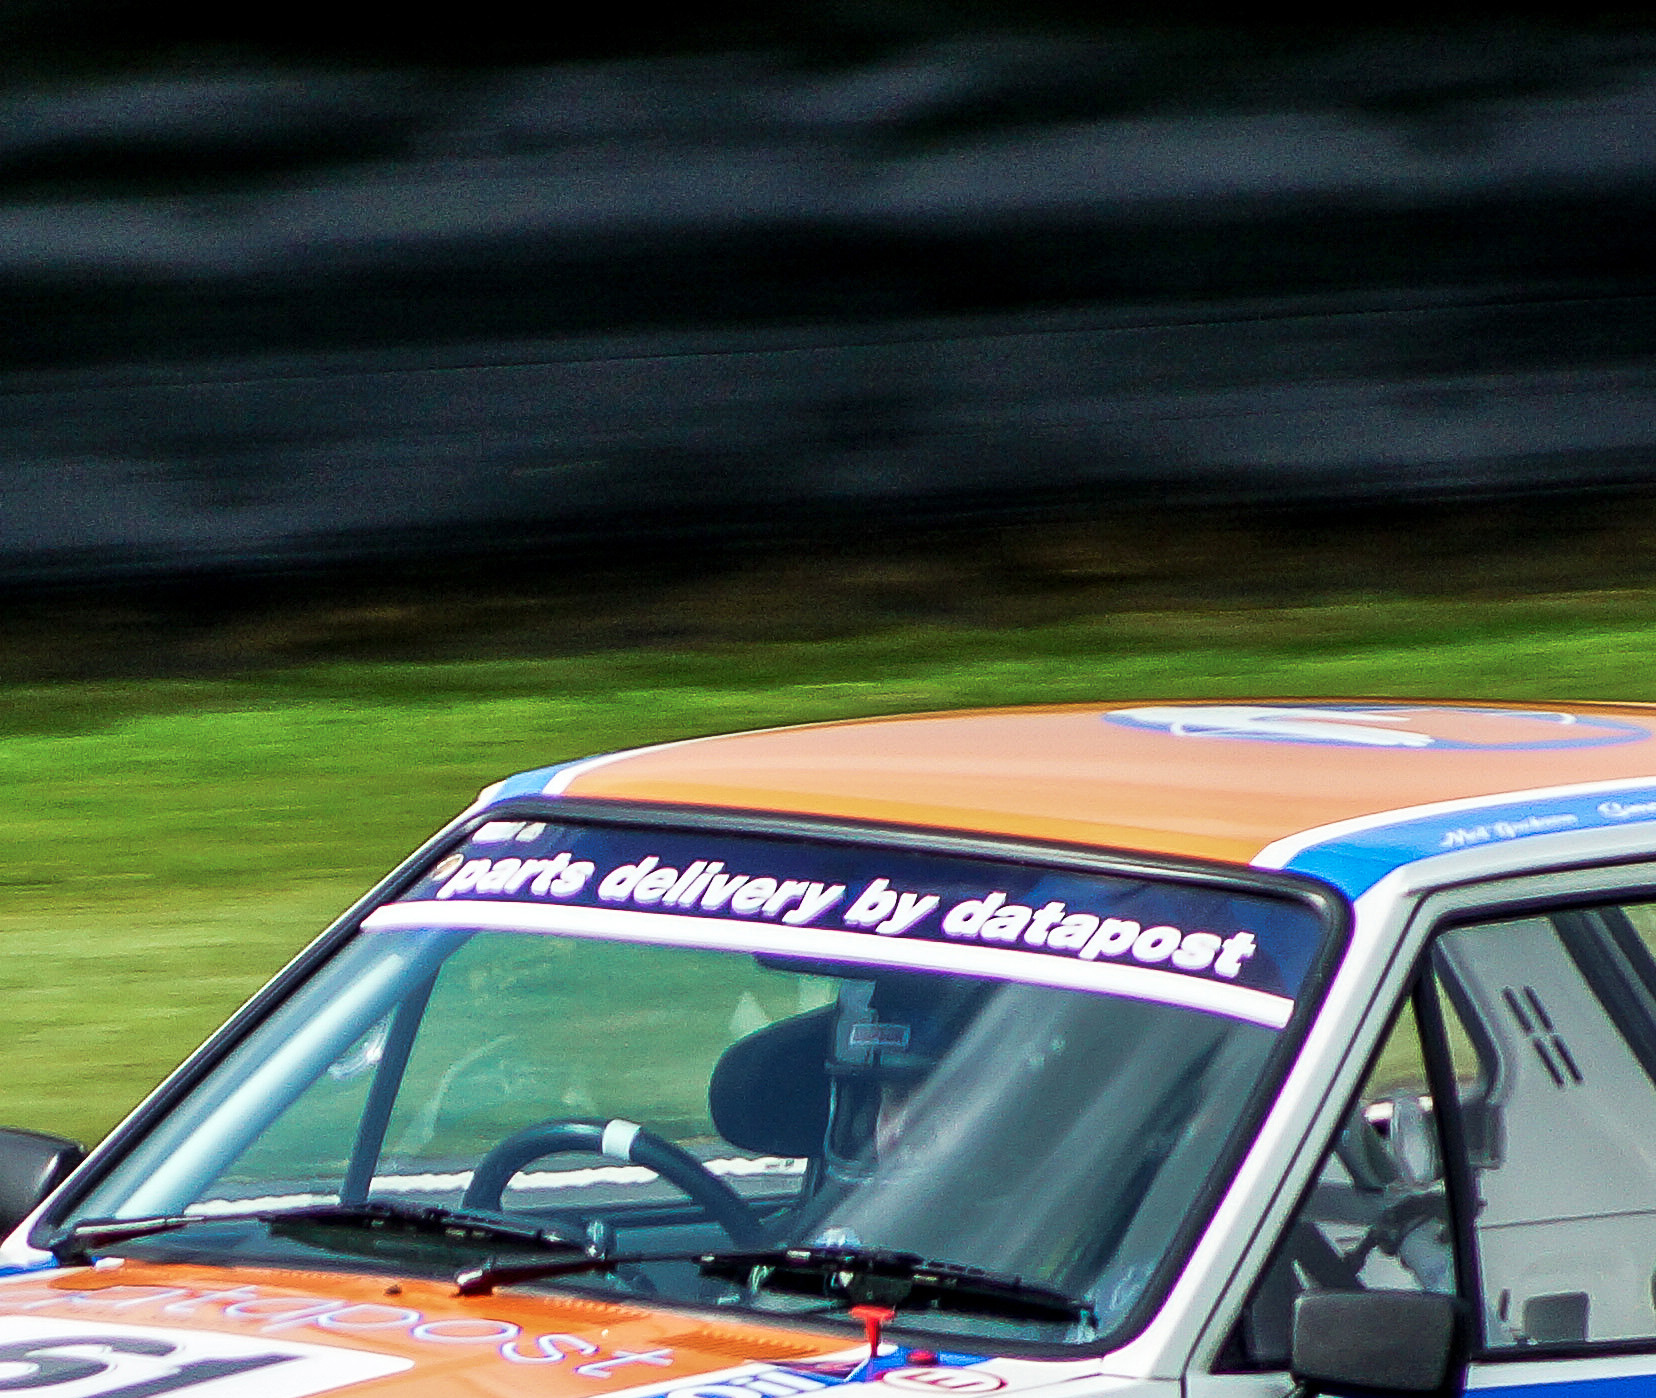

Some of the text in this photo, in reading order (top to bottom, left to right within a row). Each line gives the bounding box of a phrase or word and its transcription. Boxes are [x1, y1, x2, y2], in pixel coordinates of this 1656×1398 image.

[436, 852, 1261, 978] parts delivery by datapost
